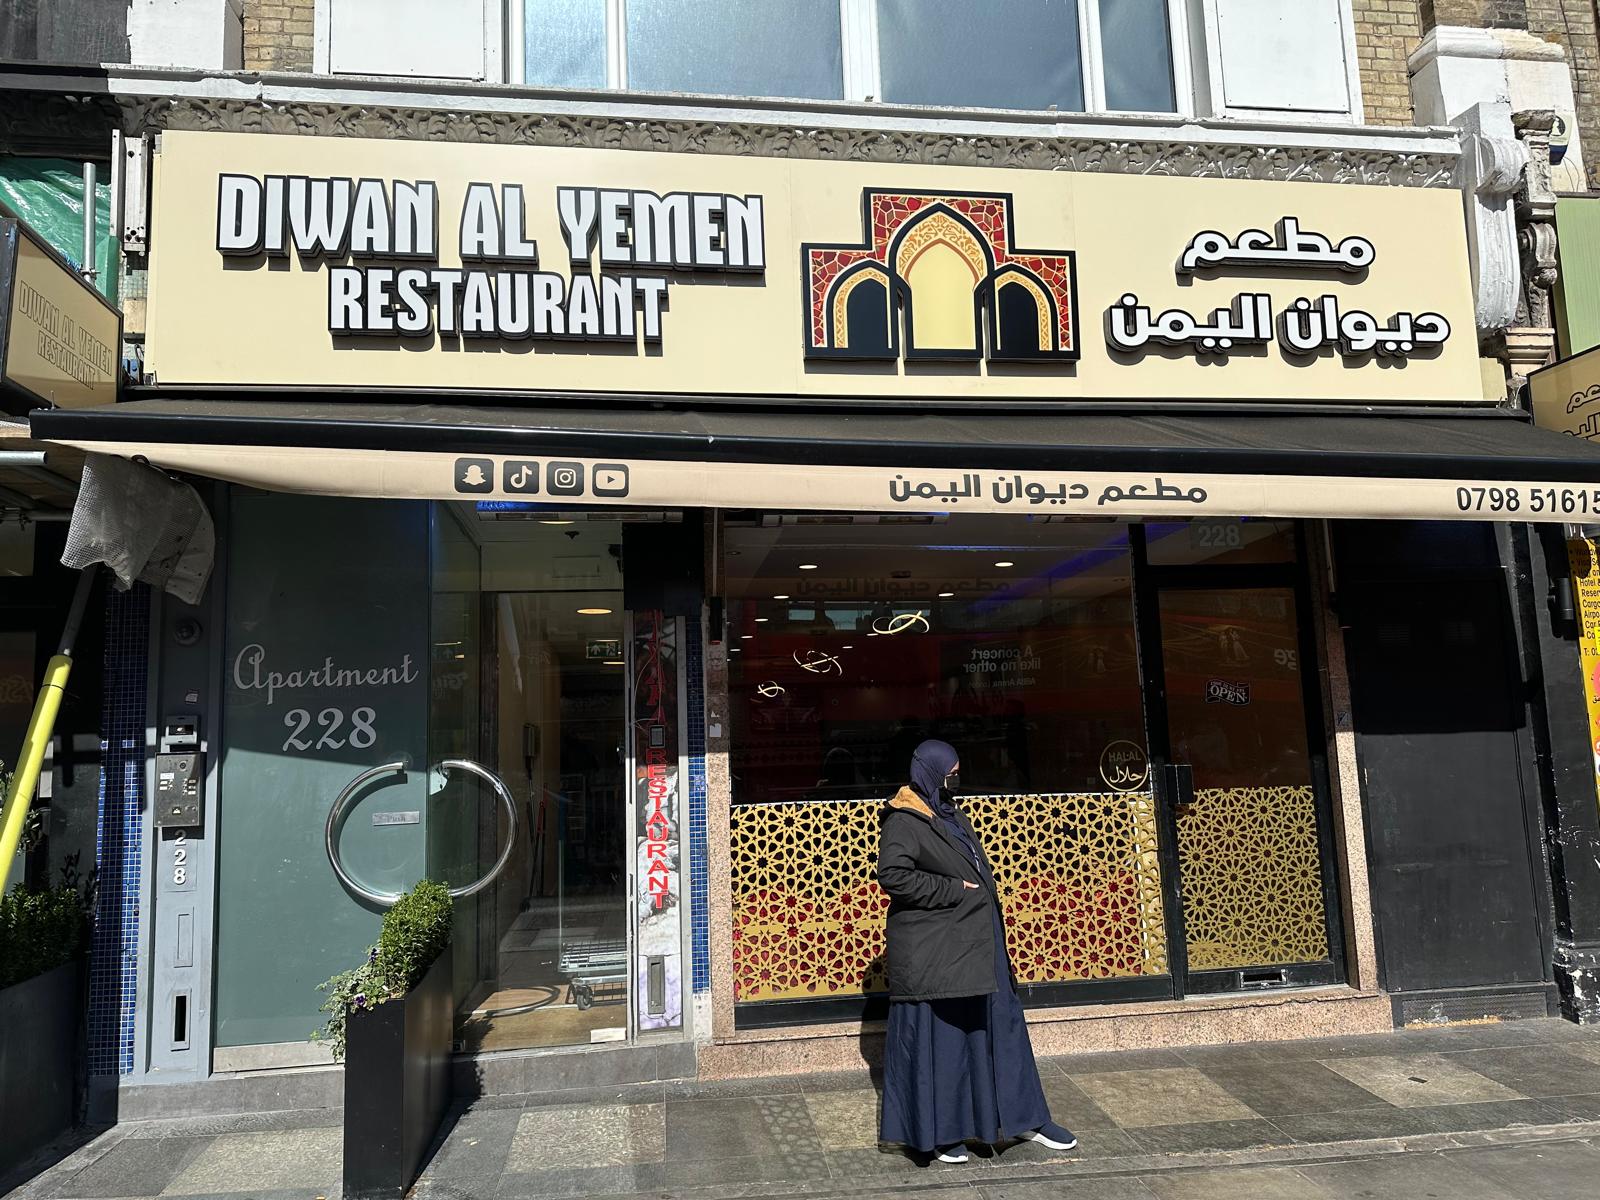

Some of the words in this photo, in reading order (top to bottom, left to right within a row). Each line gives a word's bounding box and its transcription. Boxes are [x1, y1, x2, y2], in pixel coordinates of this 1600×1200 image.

[217, 173, 438, 261] DIWAN
[459, 182, 539, 263] AL
[557, 186, 766, 274] YEMEN
[1180, 217, 1376, 270] مطعم
[328, 265, 668, 342] RESTAURANT
[1105, 293, 1274, 350] اليمن
[1278, 294, 1451, 353] ديوان
[19, 280, 60, 338] DIWAN
[61, 314, 76, 350] AL
[79, 326, 113, 377] YEMEN
[38, 330, 96, 391] RESTAURANT
[889, 473, 982, 503] اليمن
[992, 475, 1089, 505] ديوان
[1097, 477, 1208, 506] مطعم
[1456, 486, 1520, 512] 0798
[1198, 524, 1240, 547] 228
[1580, 577, 1596, 588] Hotel
[1585, 621, 1595, 629] Car
[233, 643, 420, 706] Apartment
[1210, 684, 1248, 704] OPEN
[282, 706, 378, 752] 228
[1109, 765, 1143, 784] حلال
[646, 748, 670, 909] RESTAURANT
[173, 828, 187, 885] 228
